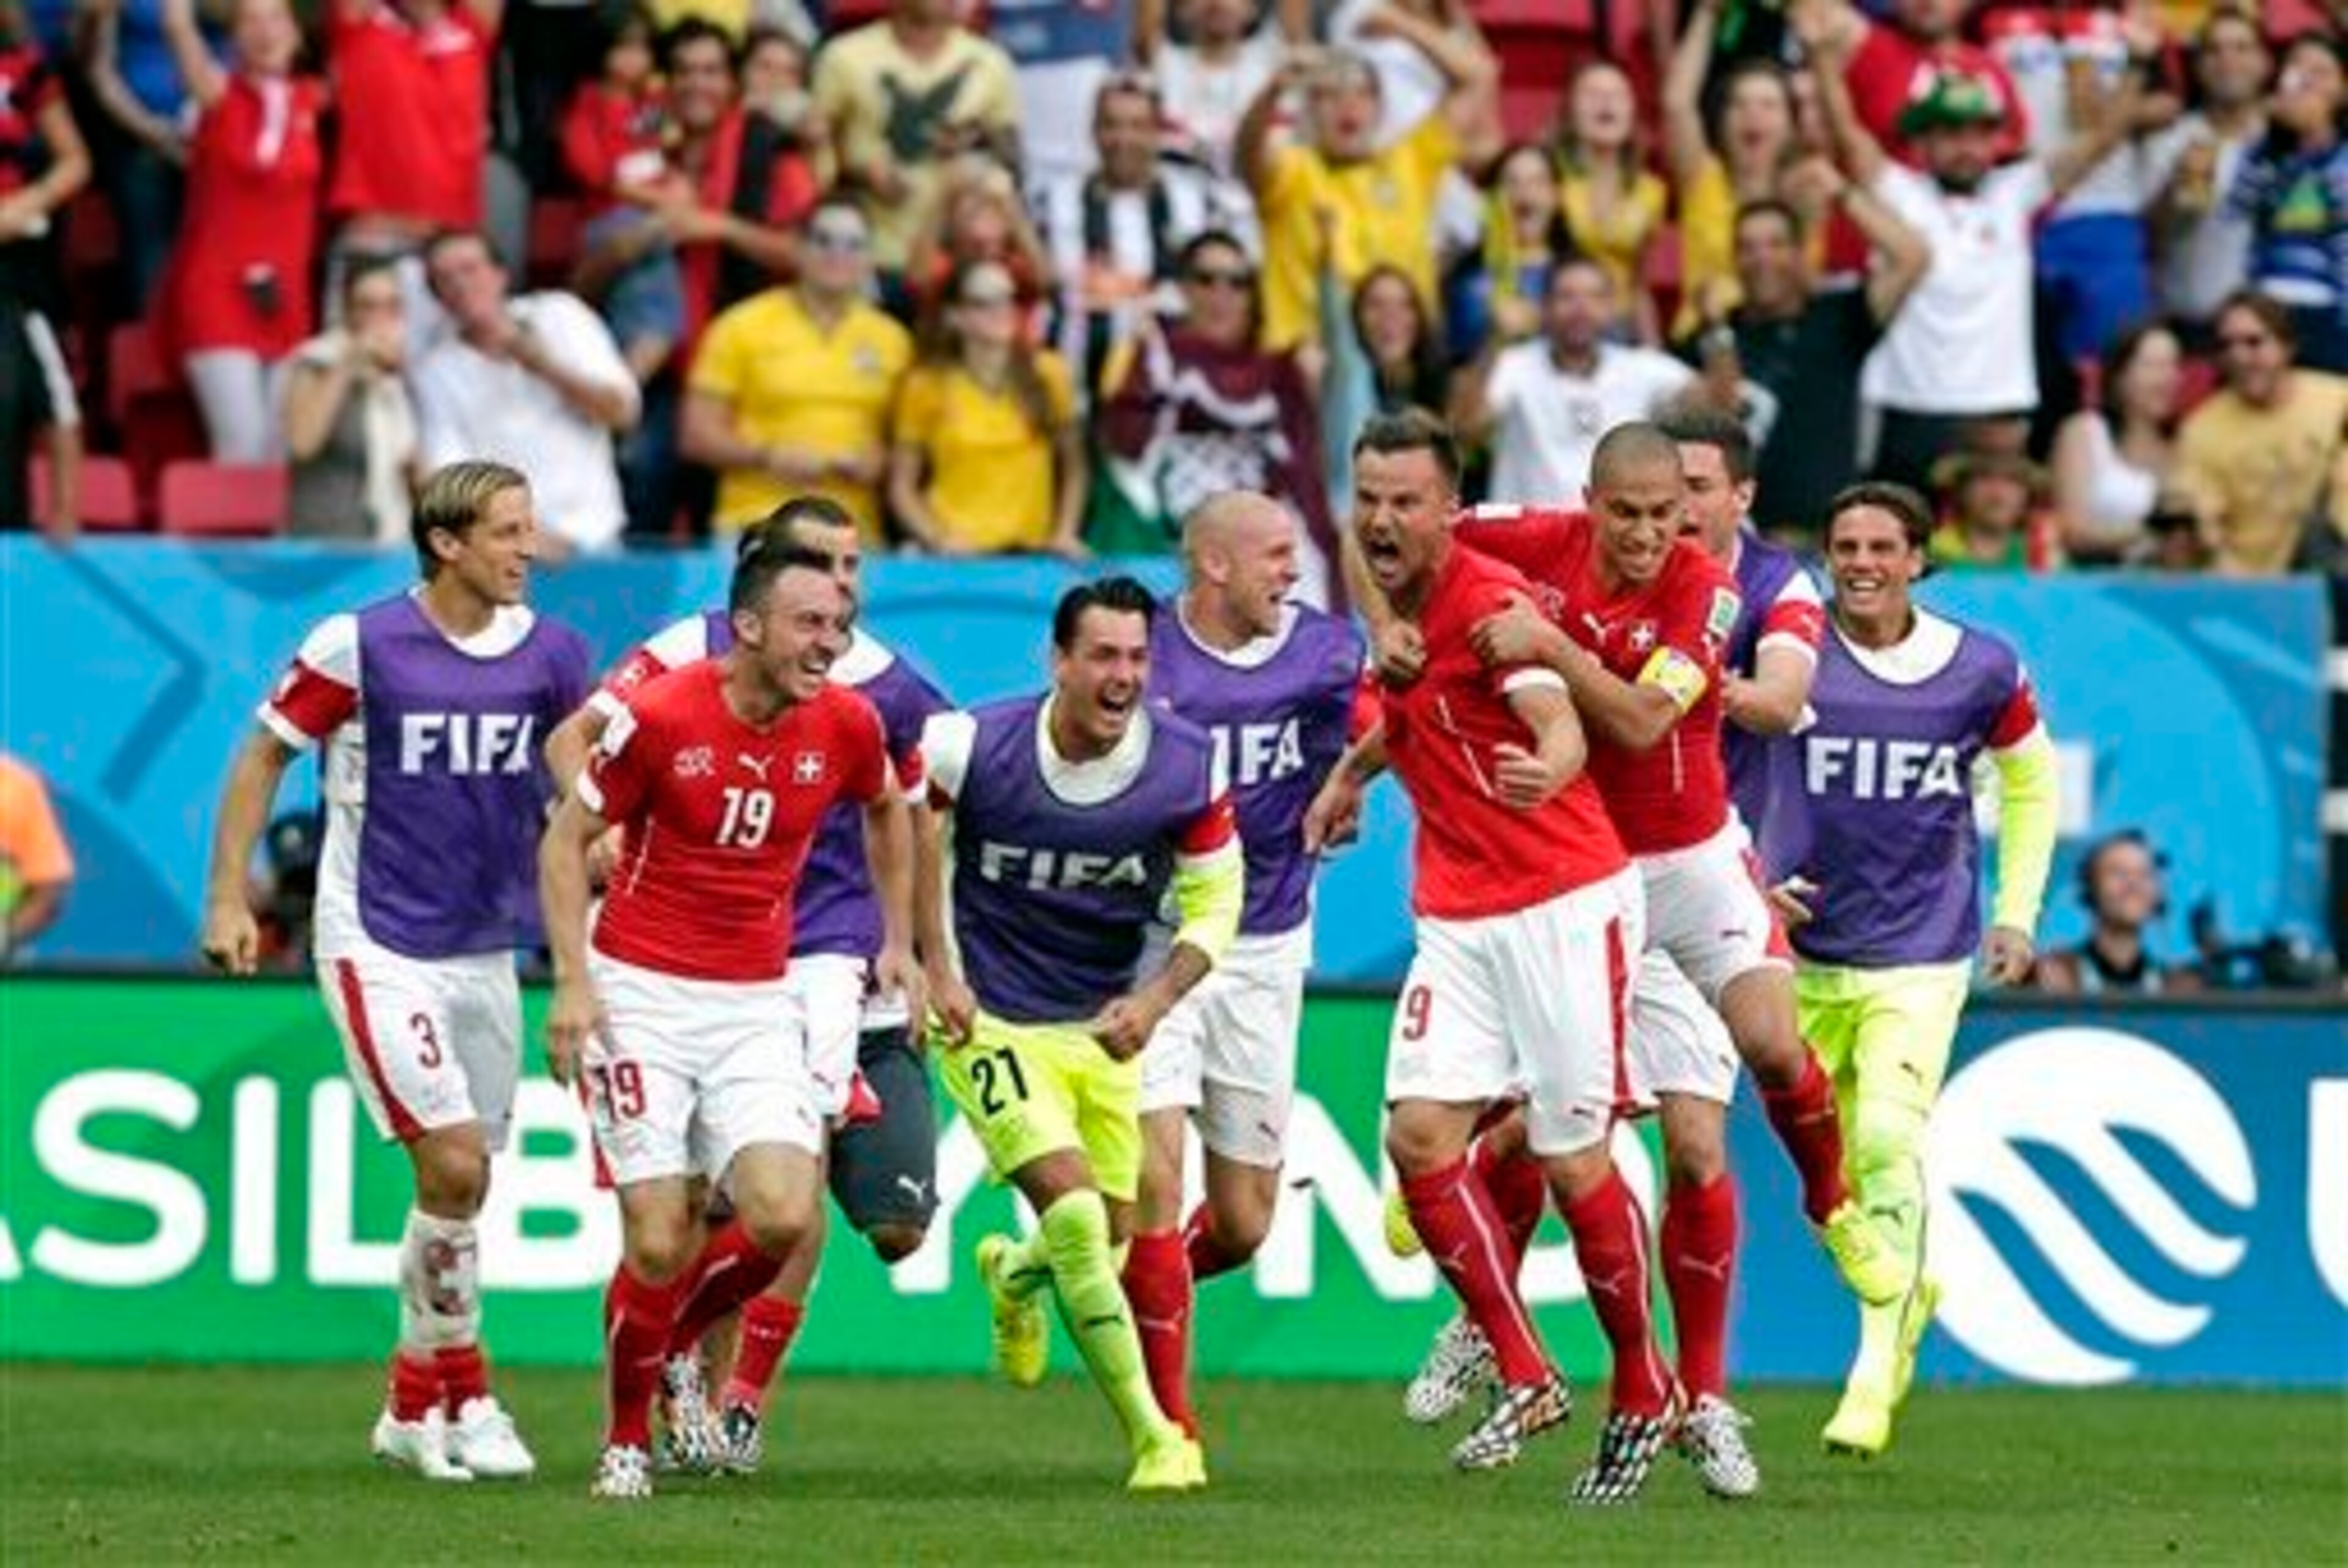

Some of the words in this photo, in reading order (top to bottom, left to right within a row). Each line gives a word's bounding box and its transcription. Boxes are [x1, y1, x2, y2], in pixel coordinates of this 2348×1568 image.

[401, 713, 533, 774] FIFA
[1209, 716, 1304, 784] IFA
[1807, 737, 1962, 799] FIFA
[715, 787, 774, 848] 19
[980, 841, 1147, 890] FIFA
[410, 1012, 441, 1069] 3
[1402, 985, 1431, 1041] 9
[591, 1062, 646, 1123] 19
[971, 1048, 1028, 1115] 21
